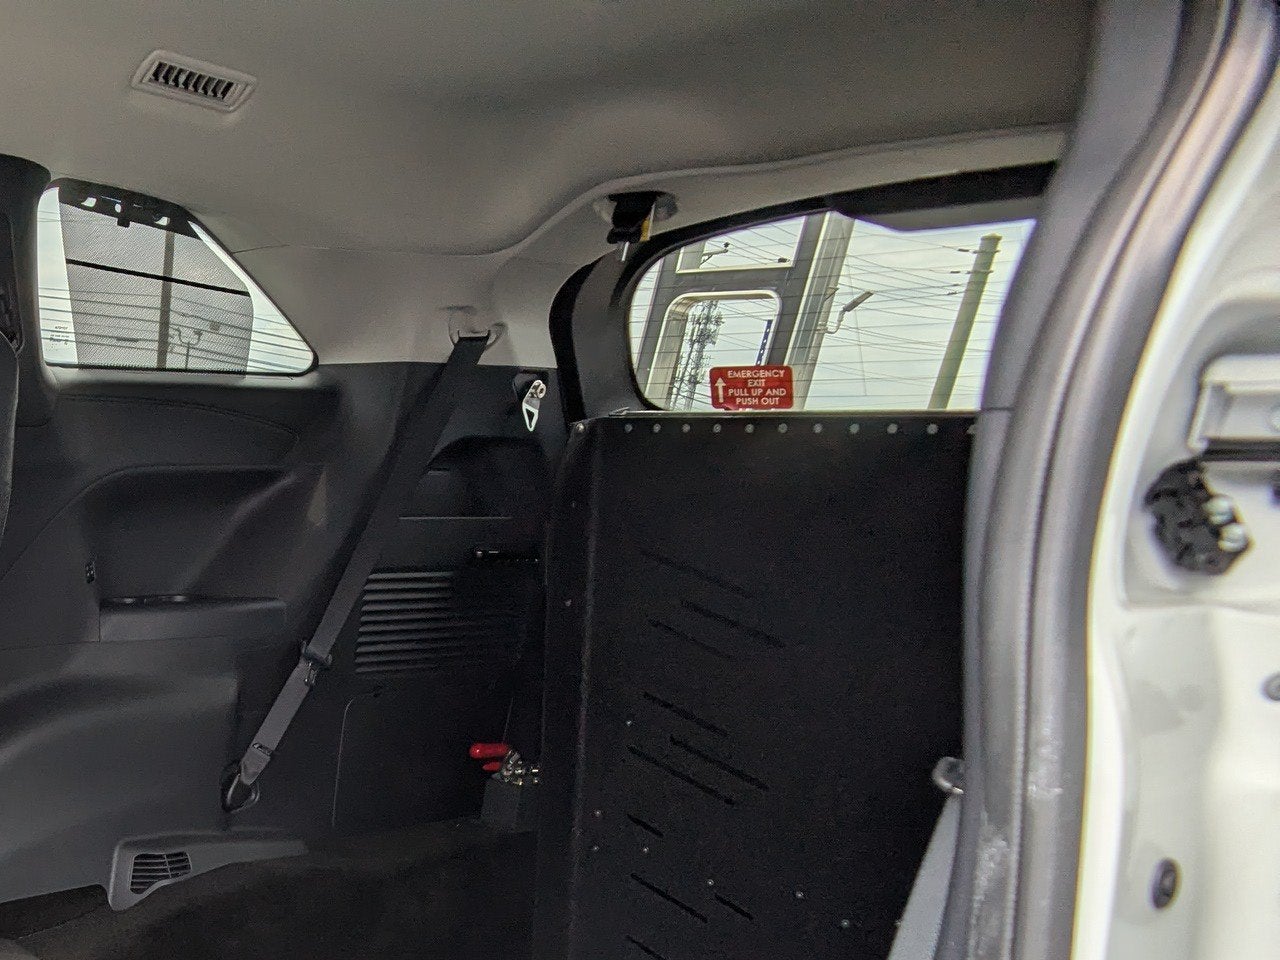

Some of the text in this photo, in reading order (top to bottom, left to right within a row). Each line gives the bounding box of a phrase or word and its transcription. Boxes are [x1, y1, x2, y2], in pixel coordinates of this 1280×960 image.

[727, 369, 786, 379] EMERGENCY
[747, 379, 766, 388] EXIT
[728, 388, 787, 397] PULL UP AND
[735, 397, 780, 405] PUSH OUT
